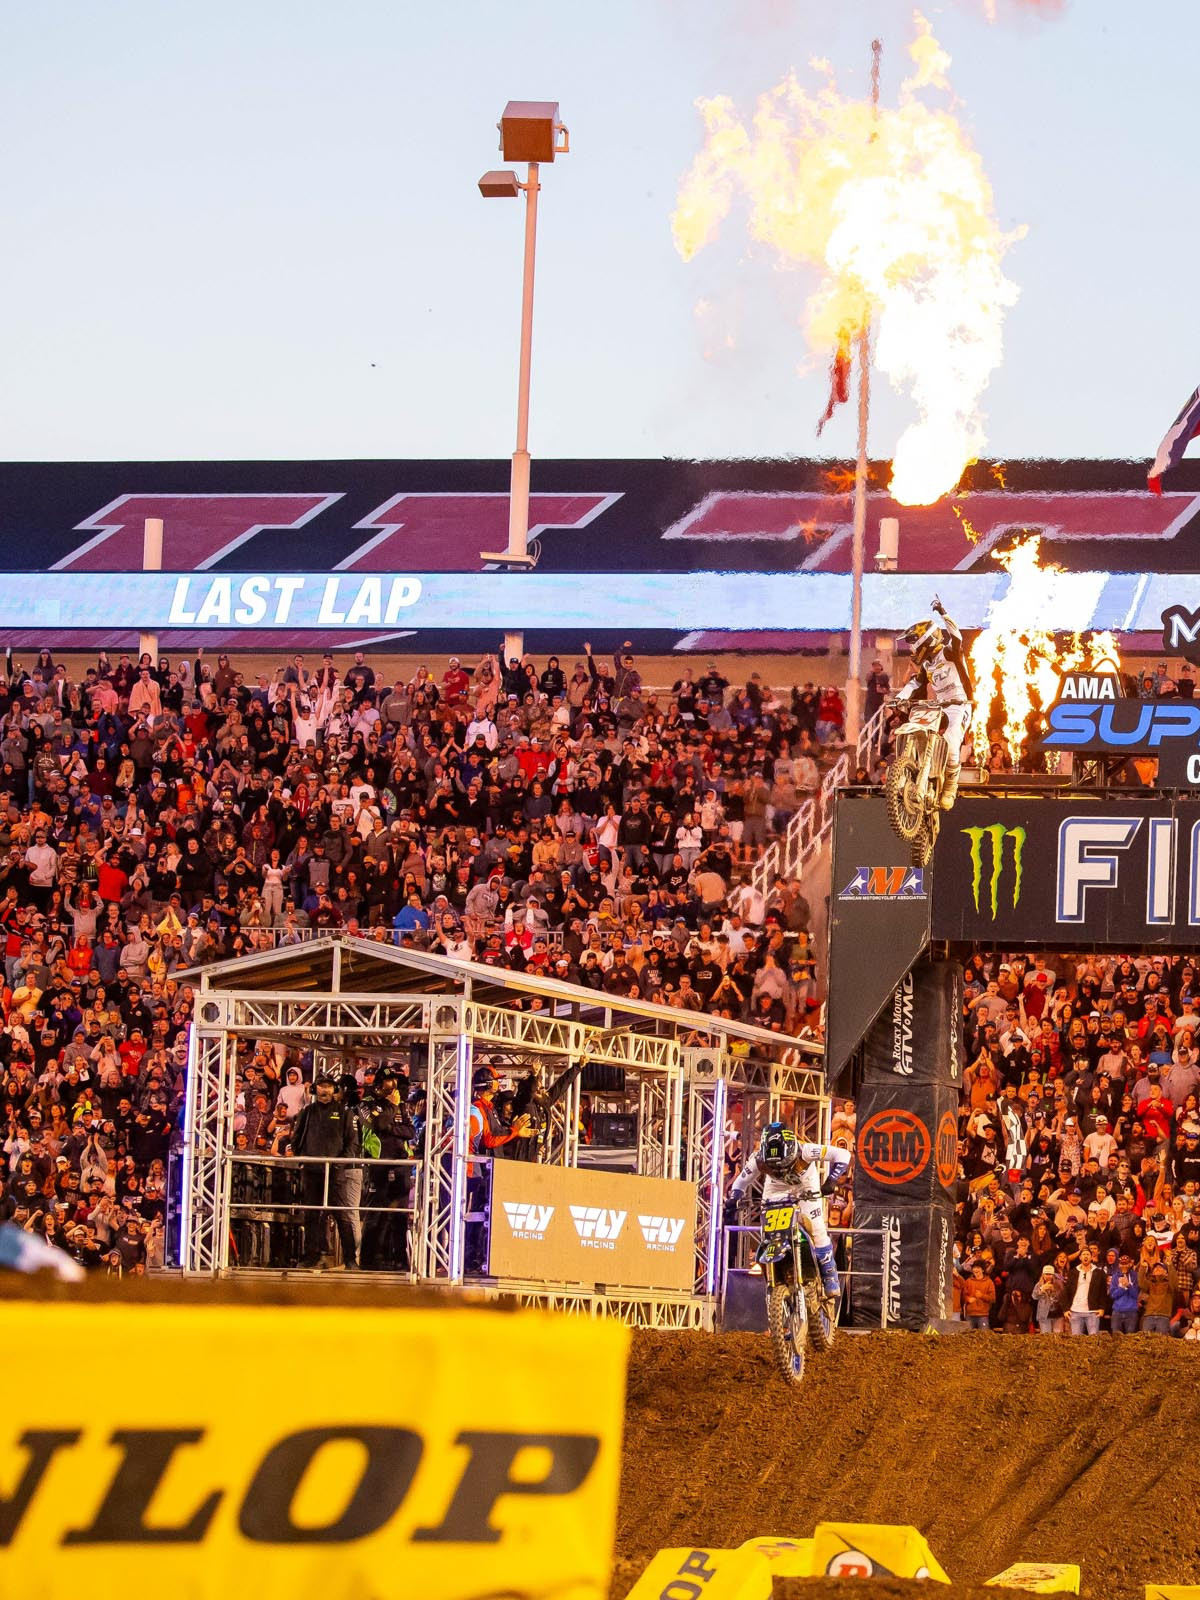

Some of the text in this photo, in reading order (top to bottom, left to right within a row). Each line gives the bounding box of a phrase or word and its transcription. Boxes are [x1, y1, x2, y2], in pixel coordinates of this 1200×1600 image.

[168, 576, 422, 624] LAST LAP
[1061, 676, 1115, 699] AMA
[837, 866, 928, 895] AMA
[892, 1027, 901, 1060] ROCKY
[871, 1132, 917, 1162] RM
[502, 1202, 556, 1232] FLY
[569, 1205, 628, 1239] FLY
[637, 1215, 686, 1244] FLY
[763, 1207, 795, 1232] 38
[512, 1231, 544, 1240] RACING
[580, 1239, 616, 1250] RACING
[646, 1243, 675, 1252] RACING
